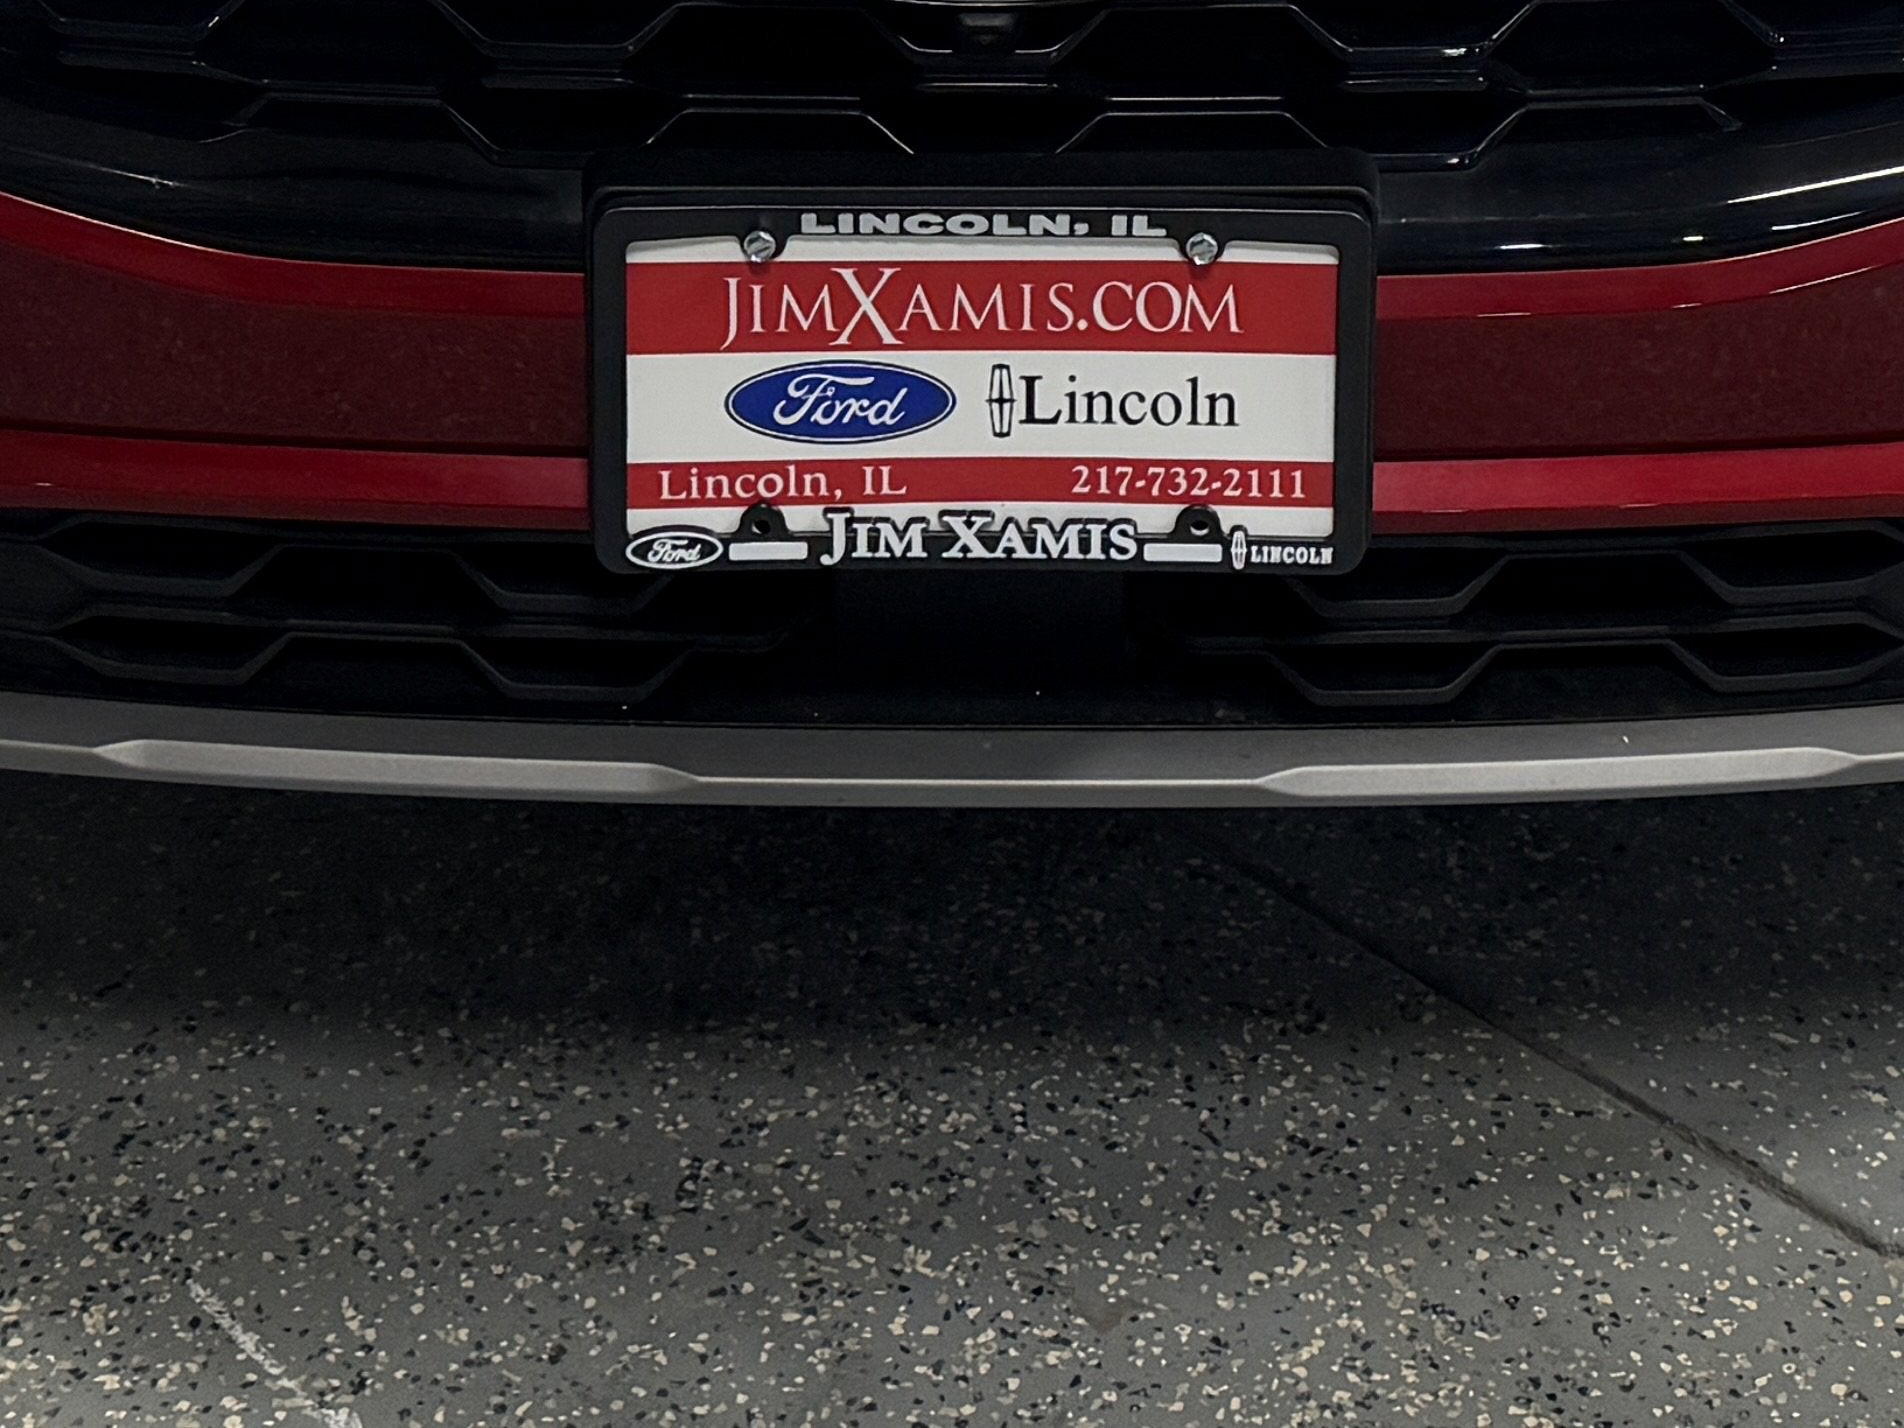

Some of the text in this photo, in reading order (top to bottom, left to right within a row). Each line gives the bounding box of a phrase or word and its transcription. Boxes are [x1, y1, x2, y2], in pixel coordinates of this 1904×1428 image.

[800, 212, 1167, 237] LINCOLN, IL
[721, 267, 1244, 350] JIMXAMIS.COM
[773, 373, 908, 425] Ford
[1018, 375, 1239, 427] Lincoln
[658, 465, 907, 501] Lincoln, IL
[1070, 465, 1306, 499] 217-732-2111
[647, 538, 701, 563] Ford
[819, 512, 1139, 566] JIM XAMIS
[1250, 545, 1334, 565] LINCOLN
